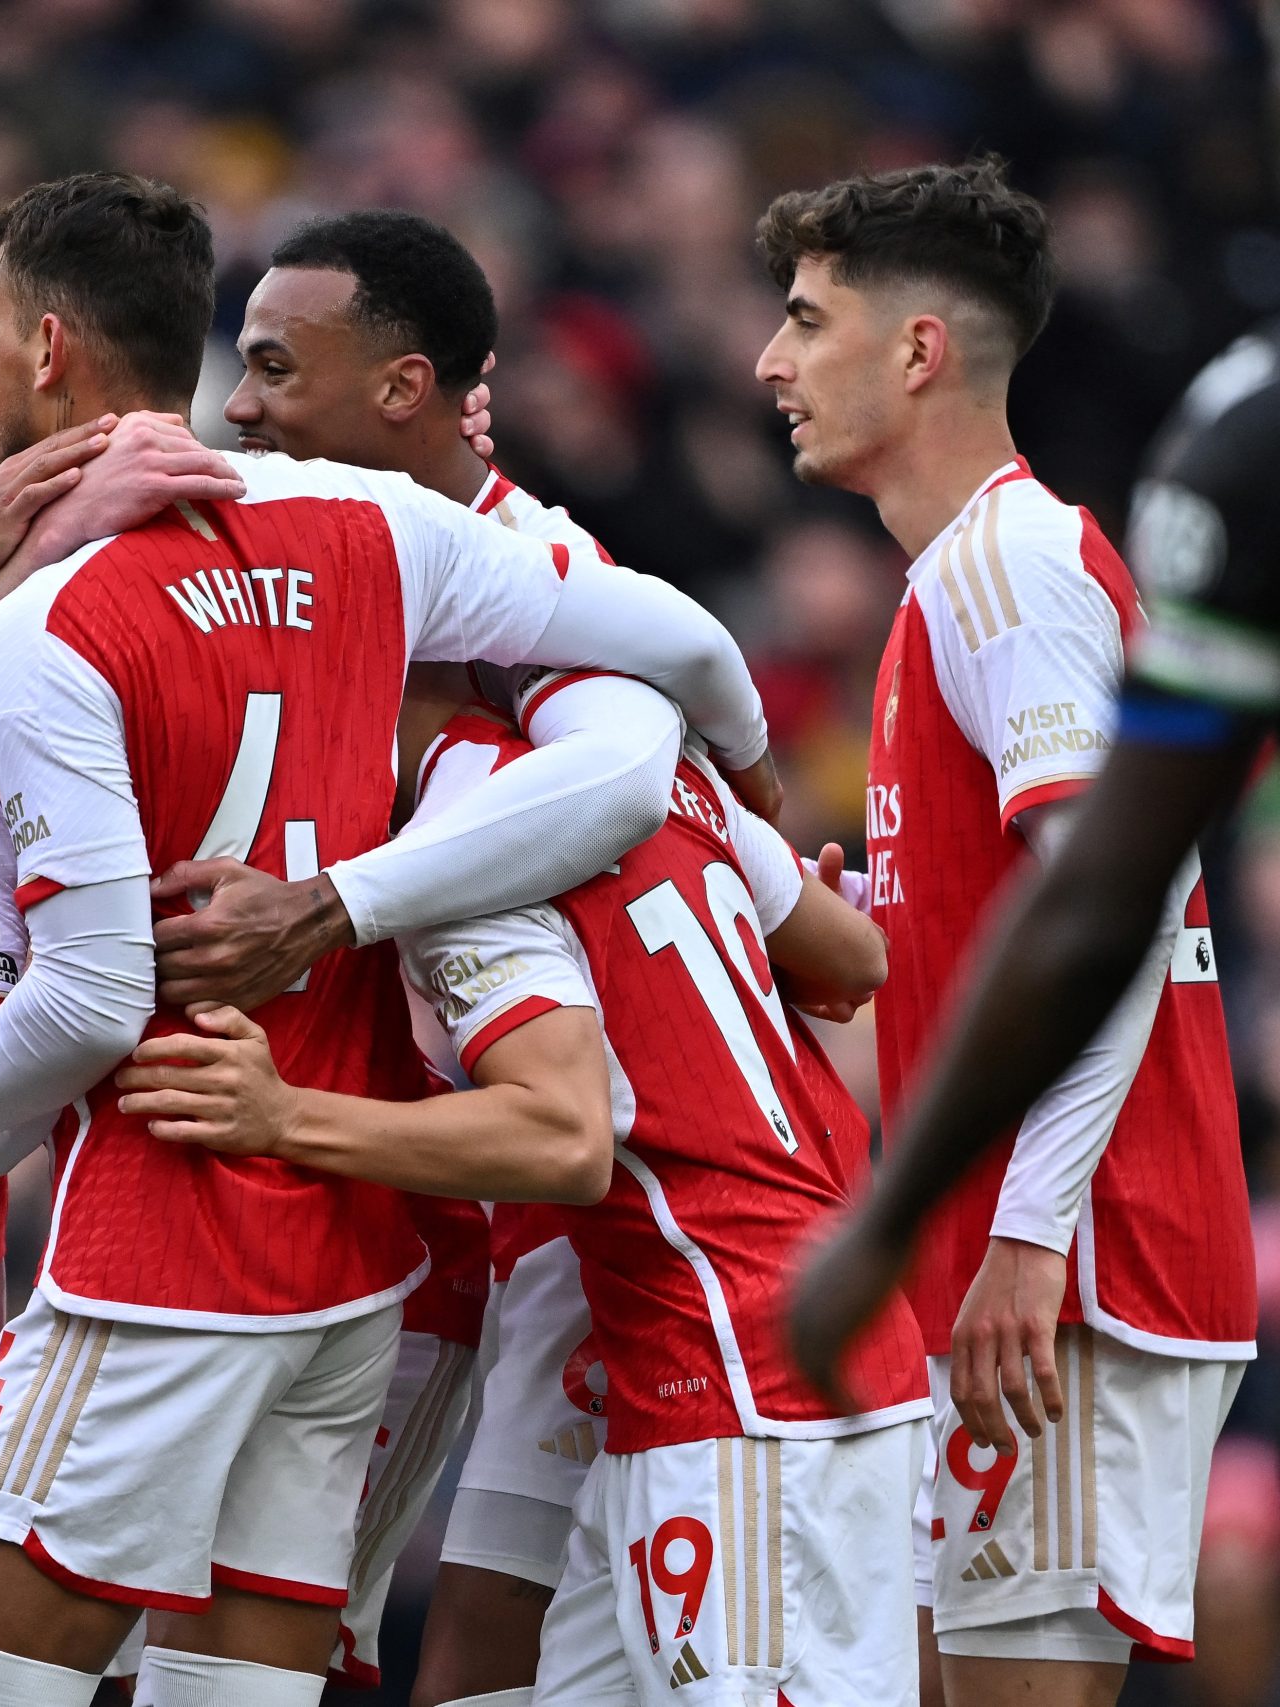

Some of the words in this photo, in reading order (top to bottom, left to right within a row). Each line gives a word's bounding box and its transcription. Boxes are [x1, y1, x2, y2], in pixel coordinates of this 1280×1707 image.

[164, 567, 314, 634] WHITE
[1007, 702, 1076, 736] VISIT
[1000, 728, 1113, 780] RWANDA
[658, 1376, 708, 1400] HEAT.RDY
[930, 1423, 1019, 1542] 9
[628, 1515, 714, 1656] 19
